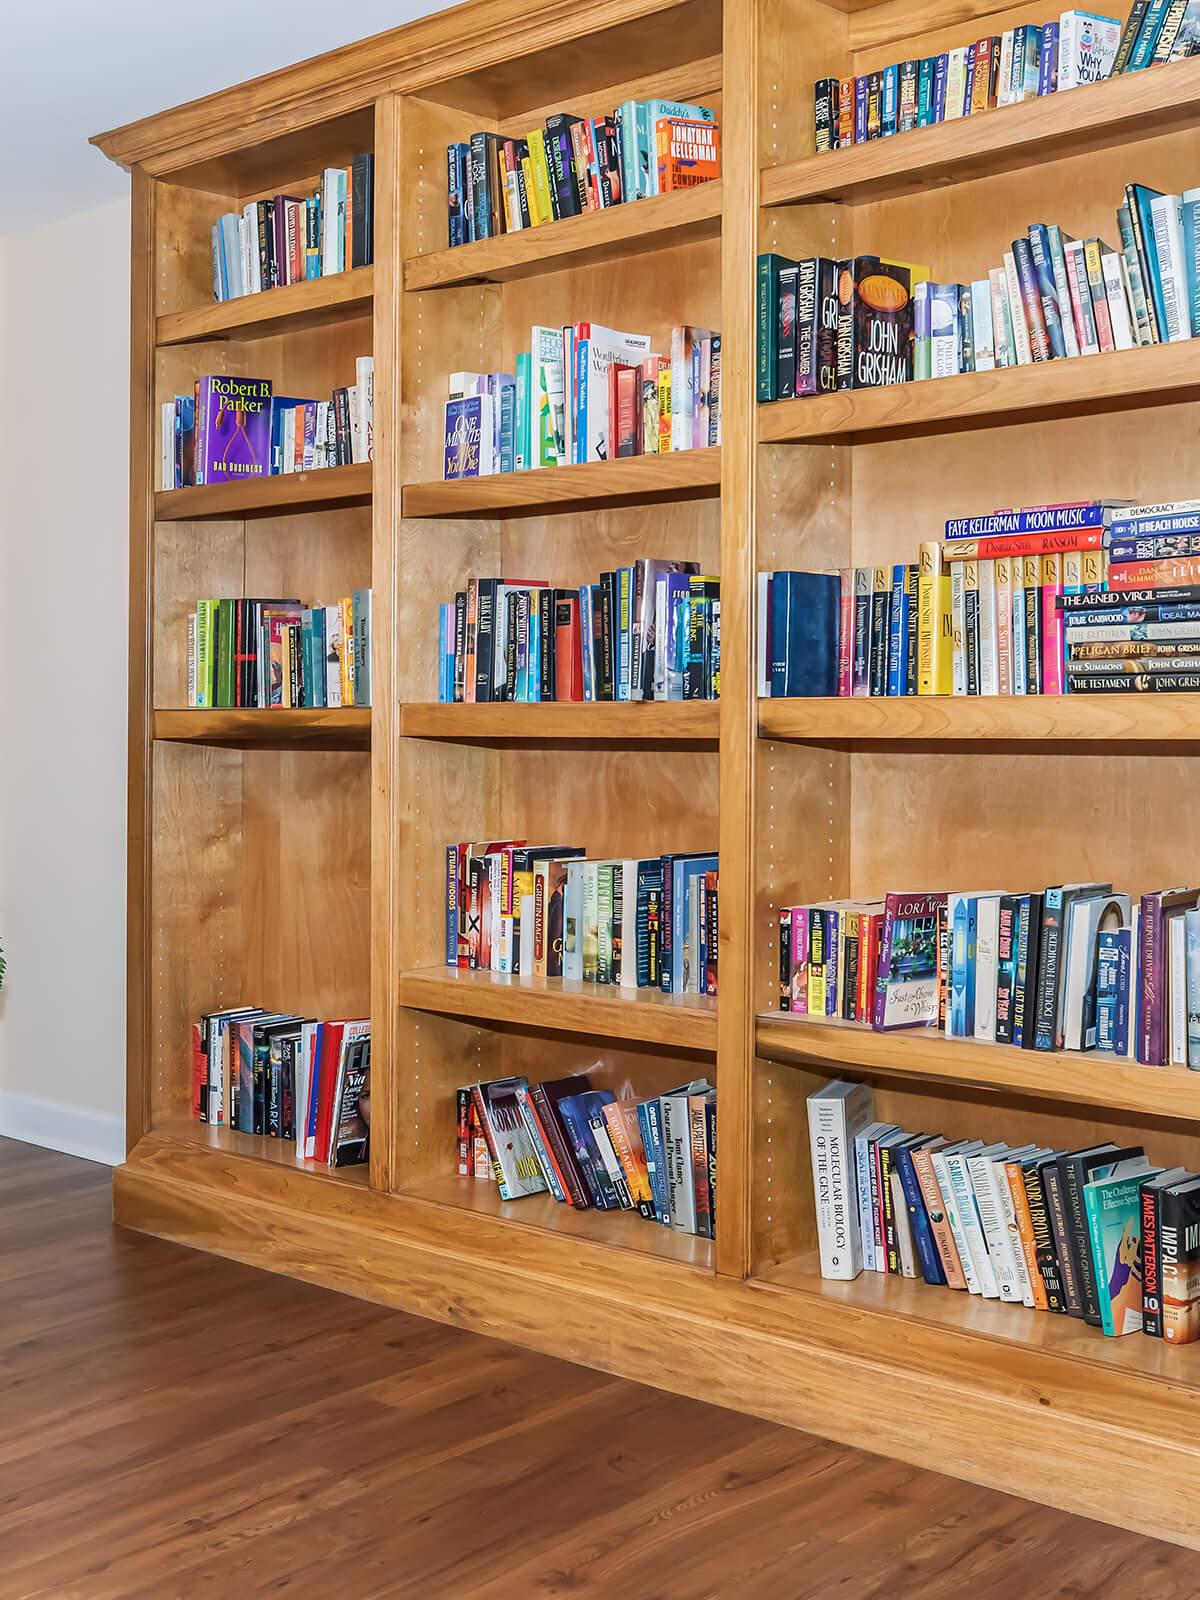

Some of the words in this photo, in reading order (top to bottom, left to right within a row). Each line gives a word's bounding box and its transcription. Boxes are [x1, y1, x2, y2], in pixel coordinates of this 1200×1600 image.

[1080, 53, 1102, 68] WHY
[1134, 40, 1149, 66] MARTIN
[1078, 65, 1095, 80] YOU
[660, 104, 689, 118] Daddy's
[672, 126, 713, 144] JONATHAN
[671, 142, 716, 161] KELLERMAN
[472, 160, 480, 184] HOAG
[800, 262, 815, 281] JOHN
[800, 281, 815, 323] GRISHAM
[801, 326, 811, 340] THE
[838, 315, 853, 336] JOHN
[869, 320, 898, 355] JOHN
[800, 341, 810, 376] CHAMBER
[838, 336, 852, 376] GRISHAM
[858, 352, 906, 385] GRISHAM
[212, 379, 257, 397] Robert
[260, 383, 271, 397] B.
[219, 396, 263, 413] Parker
[455, 416, 477, 431] ONE
[445, 429, 480, 448] MINUTE
[213, 461, 226, 471] BAD
[230, 463, 263, 473] BUSINESS
[447, 456, 462, 474] You
[461, 455, 478, 472] Die
[1130, 504, 1175, 516] DEMOCRACY
[948, 519, 968, 536] FAYE
[970, 515, 1020, 535] KELLERMAN
[1026, 512, 1055, 529] MOON
[1056, 508, 1086, 526] MUSIC
[1145, 519, 1172, 531] BEACH
[1173, 517, 1199, 528] HOUSE
[1042, 536, 1078, 548] RANSOM
[908, 571, 919, 608] DANIELLE
[922, 583, 932, 607] DANIELLE
[1062, 596, 1079, 605] THE
[1079, 594, 1119, 604] AENEID
[1122, 591, 1155, 600] VIRGIL
[480, 596, 491, 615] DARK
[480, 616, 490, 634] LADY
[908, 611, 918, 632] STEEL
[922, 608, 932, 625] STEEL
[1162, 612, 1185, 620] IDEAL
[922, 631, 931, 674] IMPOSSIBLE
[1075, 646, 1122, 656] PELICAN
[1124, 644, 1152, 654] BRIEF
[1157, 645, 1176, 653] JOHN
[1084, 662, 1123, 670] SUMMONS
[1149, 660, 1170, 670] JOHN
[1074, 679, 1088, 688] THE
[1089, 678, 1131, 688] TESTAMENT
[1156, 677, 1177, 690] JOHN
[898, 904, 924, 916] LORI
[1000, 909, 1011, 936] HARLAN
[1145, 915, 1153, 947] PURPOSE
[1000, 937, 1011, 959] COBEN
[1047, 931, 1058, 975] HOMICIDE
[998, 987, 1009, 998] SIX
[1017, 985, 1025, 1002] LAST
[1044, 977, 1055, 1017] DOUBLE
[997, 999, 1008, 1020] YEARS
[1016, 1004, 1024, 1013] TO
[1015, 1014, 1023, 1027] DIE
[269, 1102, 278, 1129] ARK
[649, 1107, 657, 1126] GREG
[664, 1103, 673, 1123] Clear
[691, 1108, 703, 1129] JAMES
[664, 1123, 673, 1143] and
[817, 1136, 824, 1148] OF
[609, 1117, 623, 1143] JOHN
[620, 1146, 634, 1173] HART
[674, 1137, 682, 1155] Tom
[692, 1130, 705, 1168] PATTERSON
[666, 1146, 676, 1181] Present
[818, 1150, 826, 1169] THE
[830, 1136, 841, 1201] MOLECULAR
[916, 1152, 929, 1173] JOHN
[675, 1156, 684, 1186] Clancy
[1066, 1164, 1075, 1181] THE
[820, 1172, 829, 1204] GENE
[922, 1174, 938, 1207] GRISHAM
[947, 1160, 965, 1194] SANDRA
[957, 1195, 972, 1228] BROWN
[1023, 1169, 1043, 1213] SANDRA
[1050, 1177, 1059, 1192] THE
[1101, 1190, 1112, 1199] The
[669, 1182, 677, 1214] Danger
[1051, 1193, 1061, 1212] LAST
[1068, 1182, 1083, 1229] TESTAMENT
[1142, 1194, 1155, 1228] JAMES
[833, 1204, 846, 1250] BIOLOGY
[1031, 1213, 1050, 1249] BROWN
[1055, 1213, 1065, 1237] JUROR
[1060, 1242, 1070, 1262] JOHN
[1074, 1235, 1085, 1258] JOHN
[1162, 1225, 1178, 1286] IMPACT
[1143, 1229, 1158, 1293] PATTERSON
[1063, 1263, 1074, 1297] GRISHAM
[1079, 1259, 1093, 1298] GRISHAM
[1143, 1296, 1159, 1310] 10
